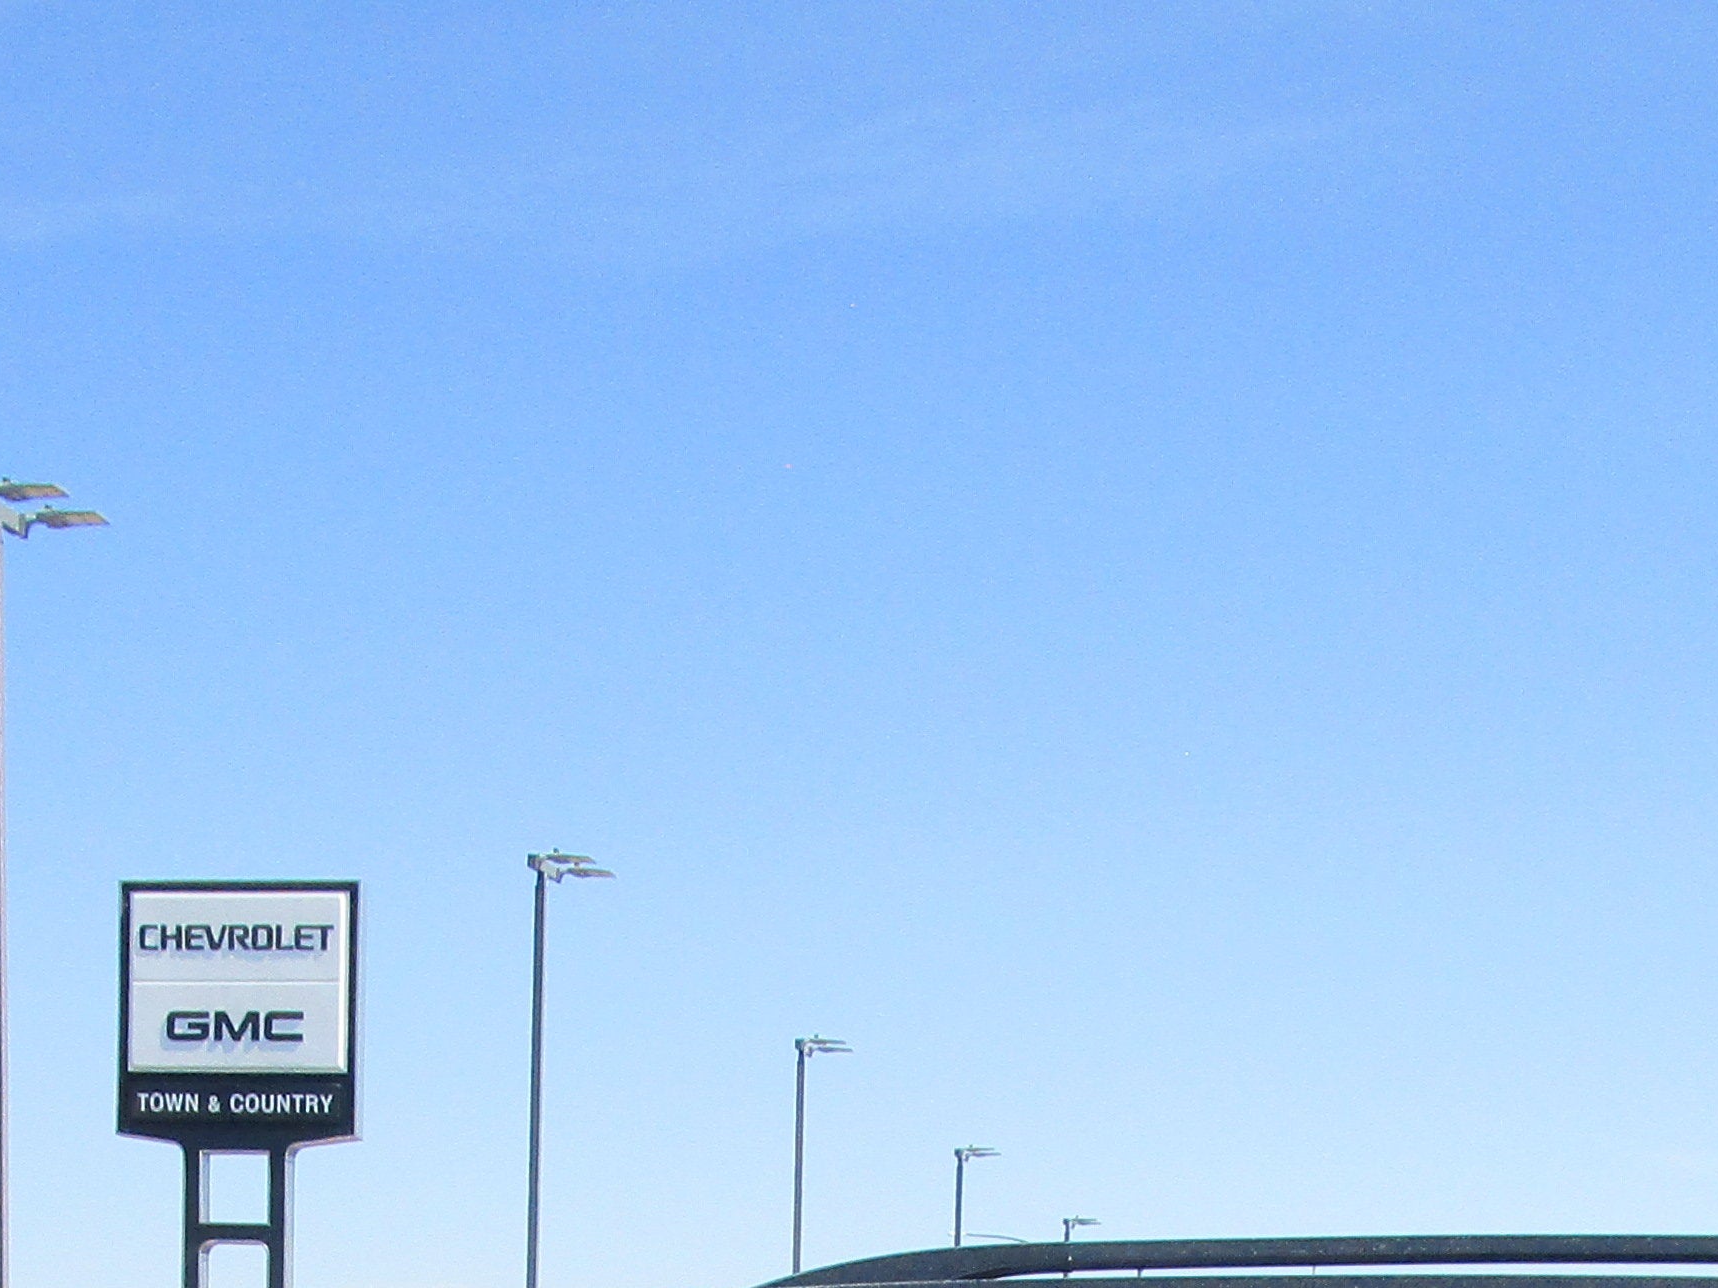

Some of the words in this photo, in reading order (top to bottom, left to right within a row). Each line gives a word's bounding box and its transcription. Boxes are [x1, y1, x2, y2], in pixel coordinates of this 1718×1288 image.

[138, 923, 335, 951] CHEVROLET
[166, 1010, 305, 1042] GMC
[136, 1092, 200, 1113] TOWN
[208, 1094, 221, 1114] &
[229, 1092, 334, 1114] COUNTRY
